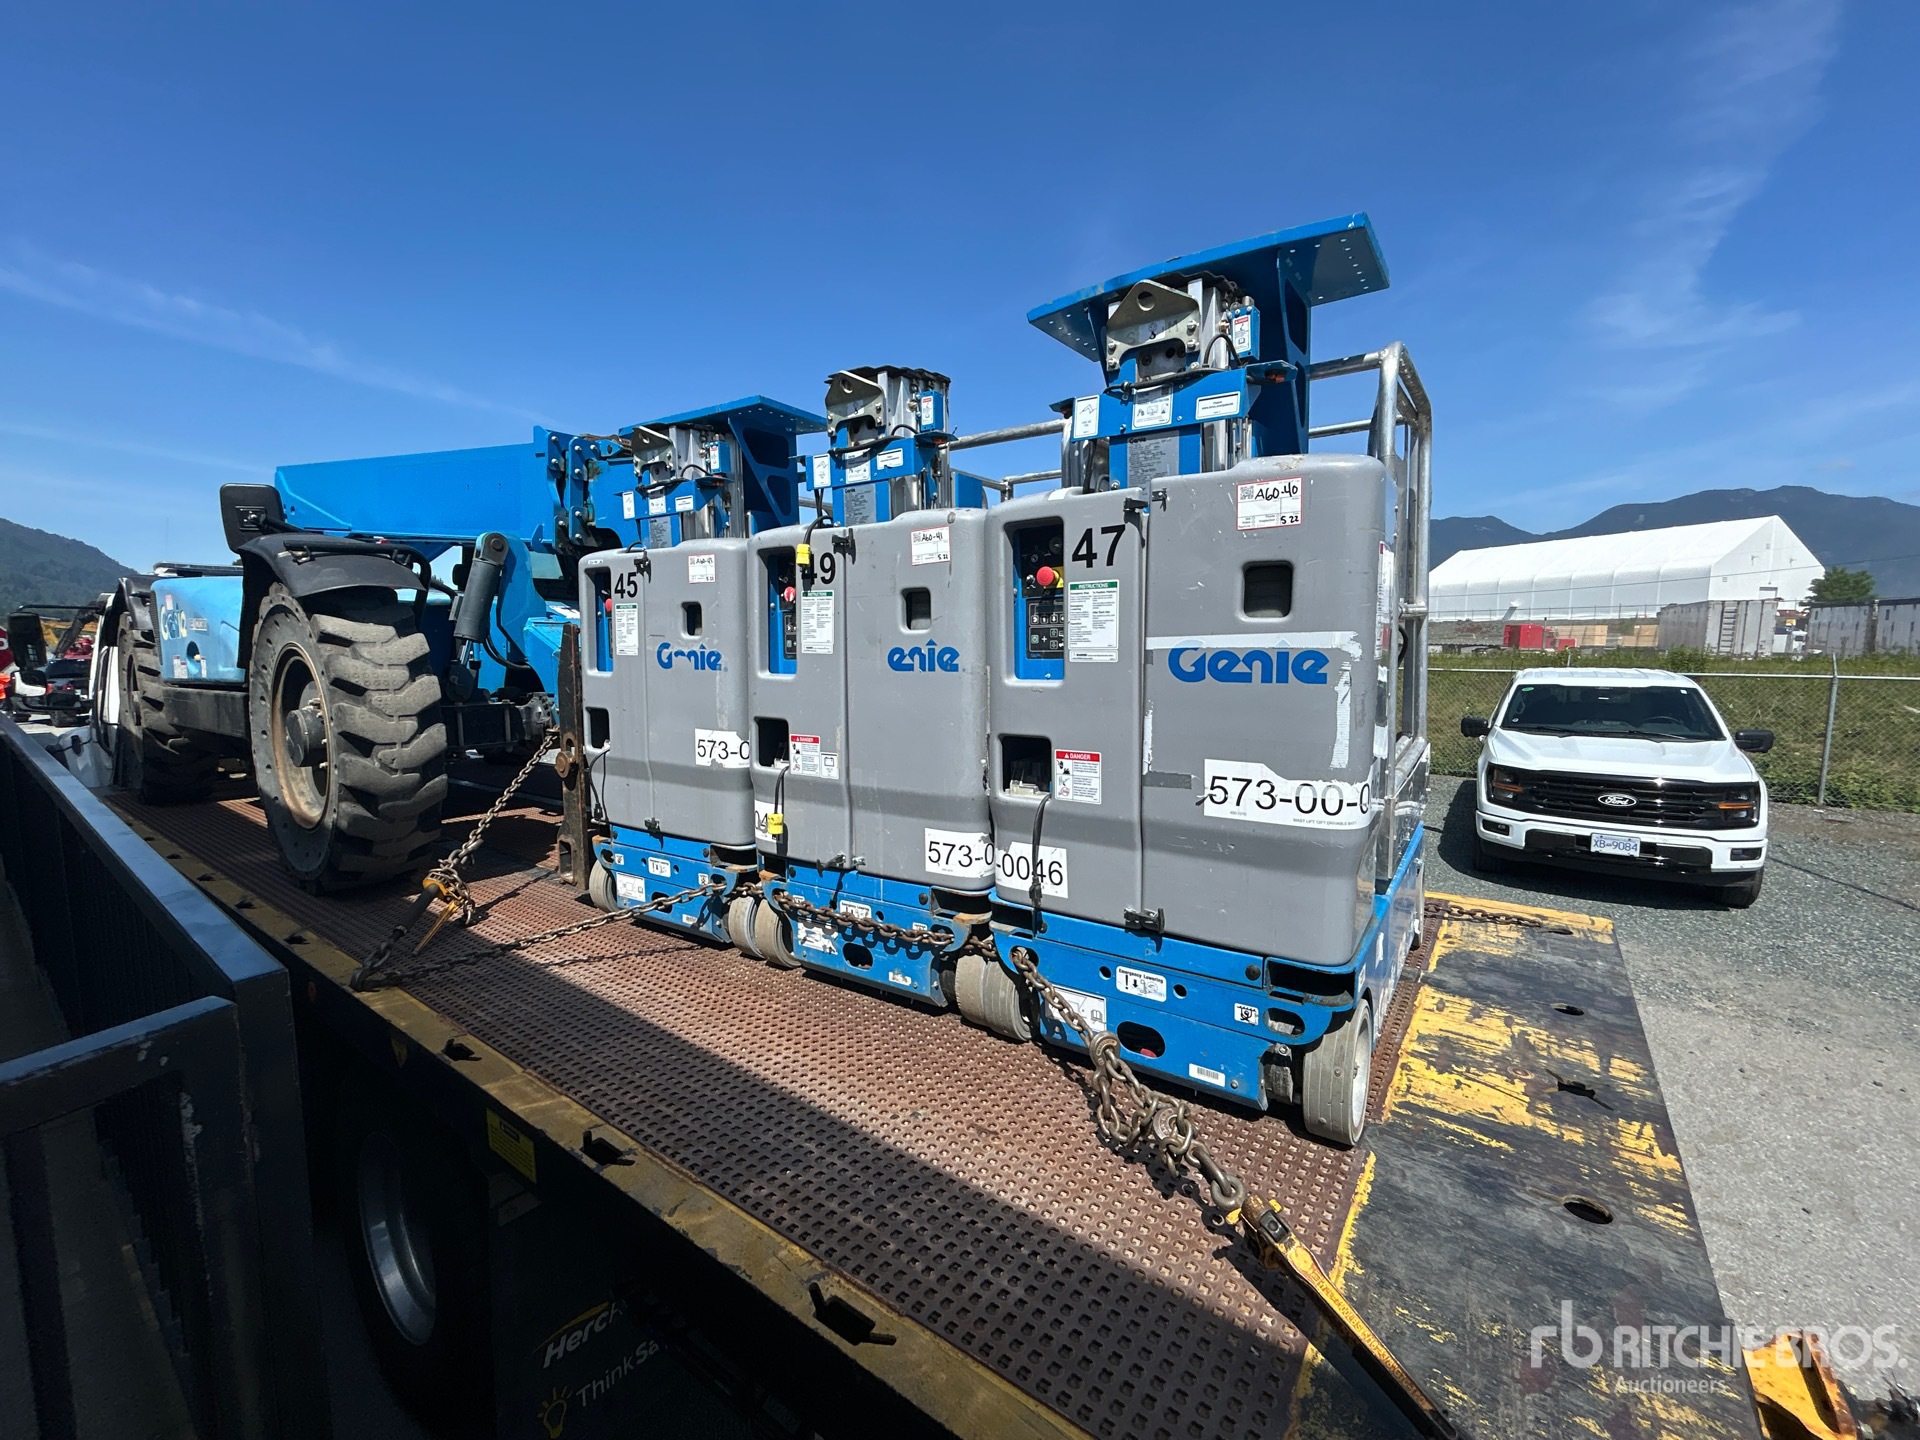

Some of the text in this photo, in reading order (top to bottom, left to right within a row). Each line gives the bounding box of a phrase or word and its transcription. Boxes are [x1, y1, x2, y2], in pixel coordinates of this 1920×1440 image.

[1255, 482, 1299, 501] A60-40
[1072, 524, 1125, 568] 47
[614, 572, 638, 599] 45
[888, 638, 960, 672] enie
[1168, 638, 1330, 684] Genie
[698, 739, 749, 760] 573-0
[1208, 775, 1370, 816] 573-00-0
[928, 840, 994, 868] 573-0
[1119, 968, 1164, 984] Emergency Lowering
